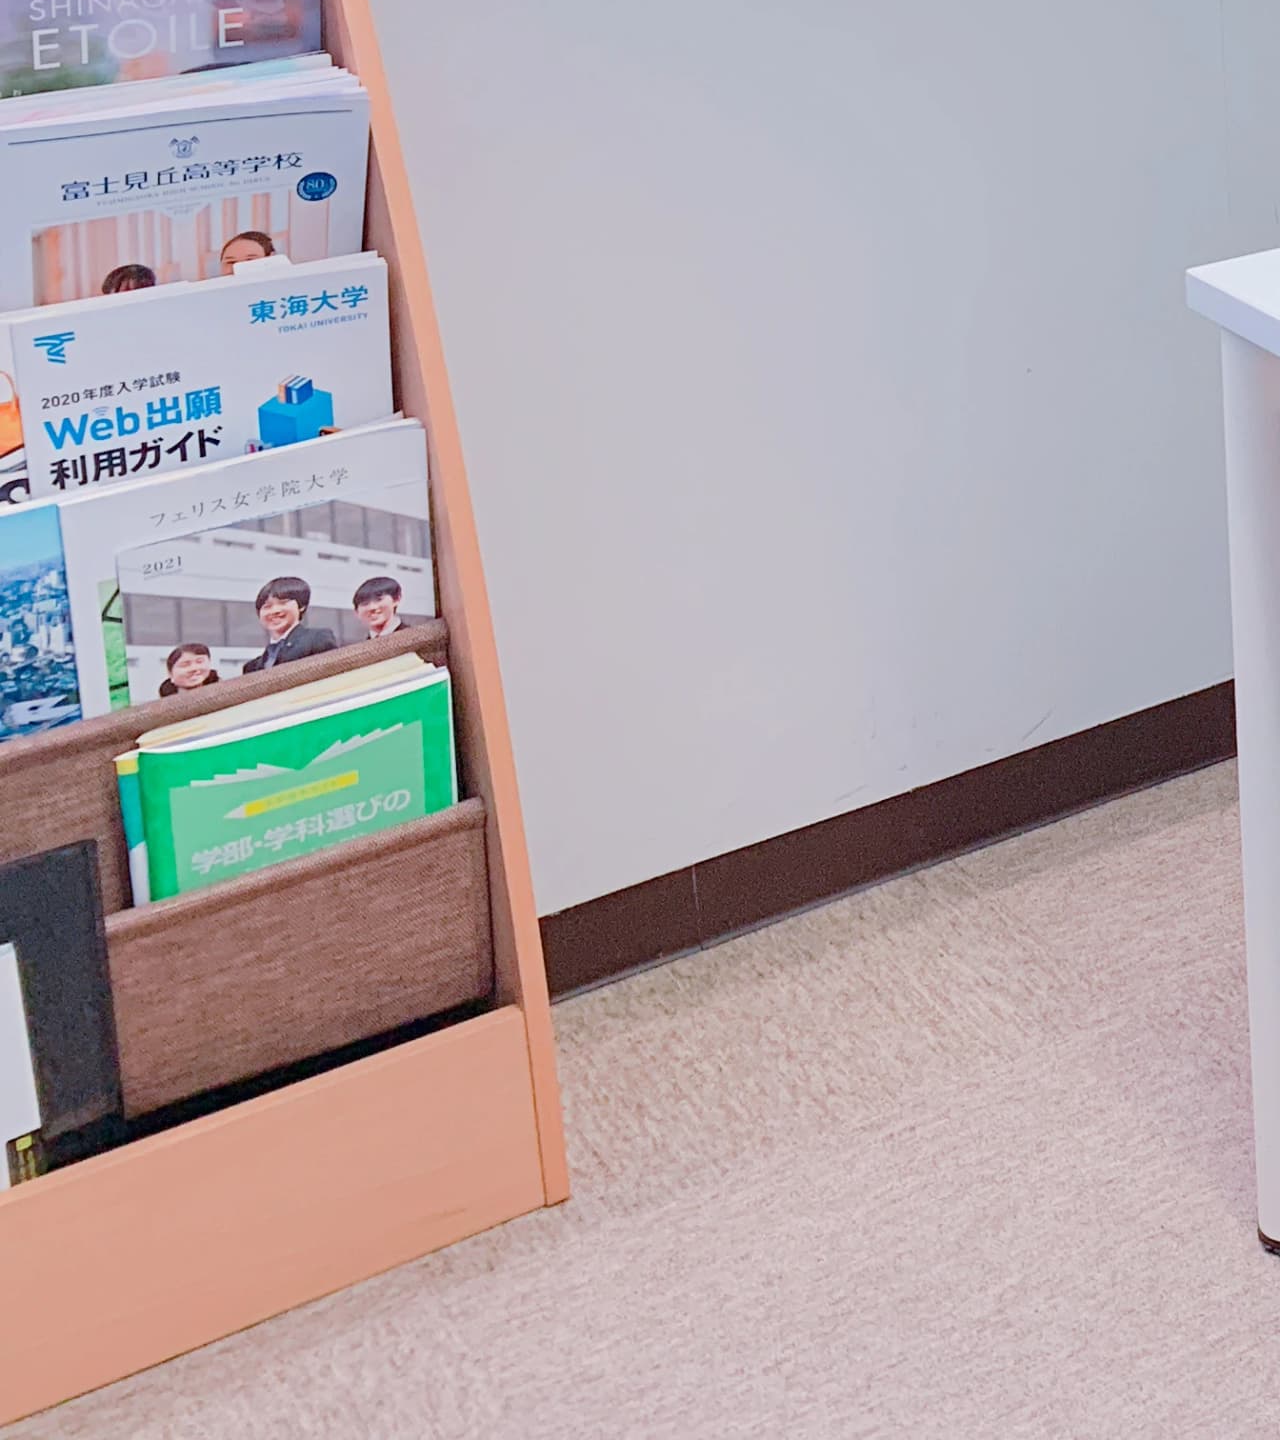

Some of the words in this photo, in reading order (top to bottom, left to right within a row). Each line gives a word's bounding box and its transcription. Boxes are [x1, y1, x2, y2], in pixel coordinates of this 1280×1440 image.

[31, 6, 245, 71] ETOILE
[60, 151, 304, 202] 富士見丘高等学校
[305, 179, 325, 191] 80
[248, 285, 369, 325] 東海大学
[277, 322, 308, 334] TOKAI
[309, 312, 369, 329] UNIVERSITY
[41, 371, 182, 410] 2020年度入学試験
[44, 385, 224, 451] Web出願
[49, 425, 225, 491] 利用ガイド
[149, 467, 351, 529] フェリス女学院大学
[141, 554, 184, 576] 2021
[190, 788, 412, 877] 学部・学科選びの
